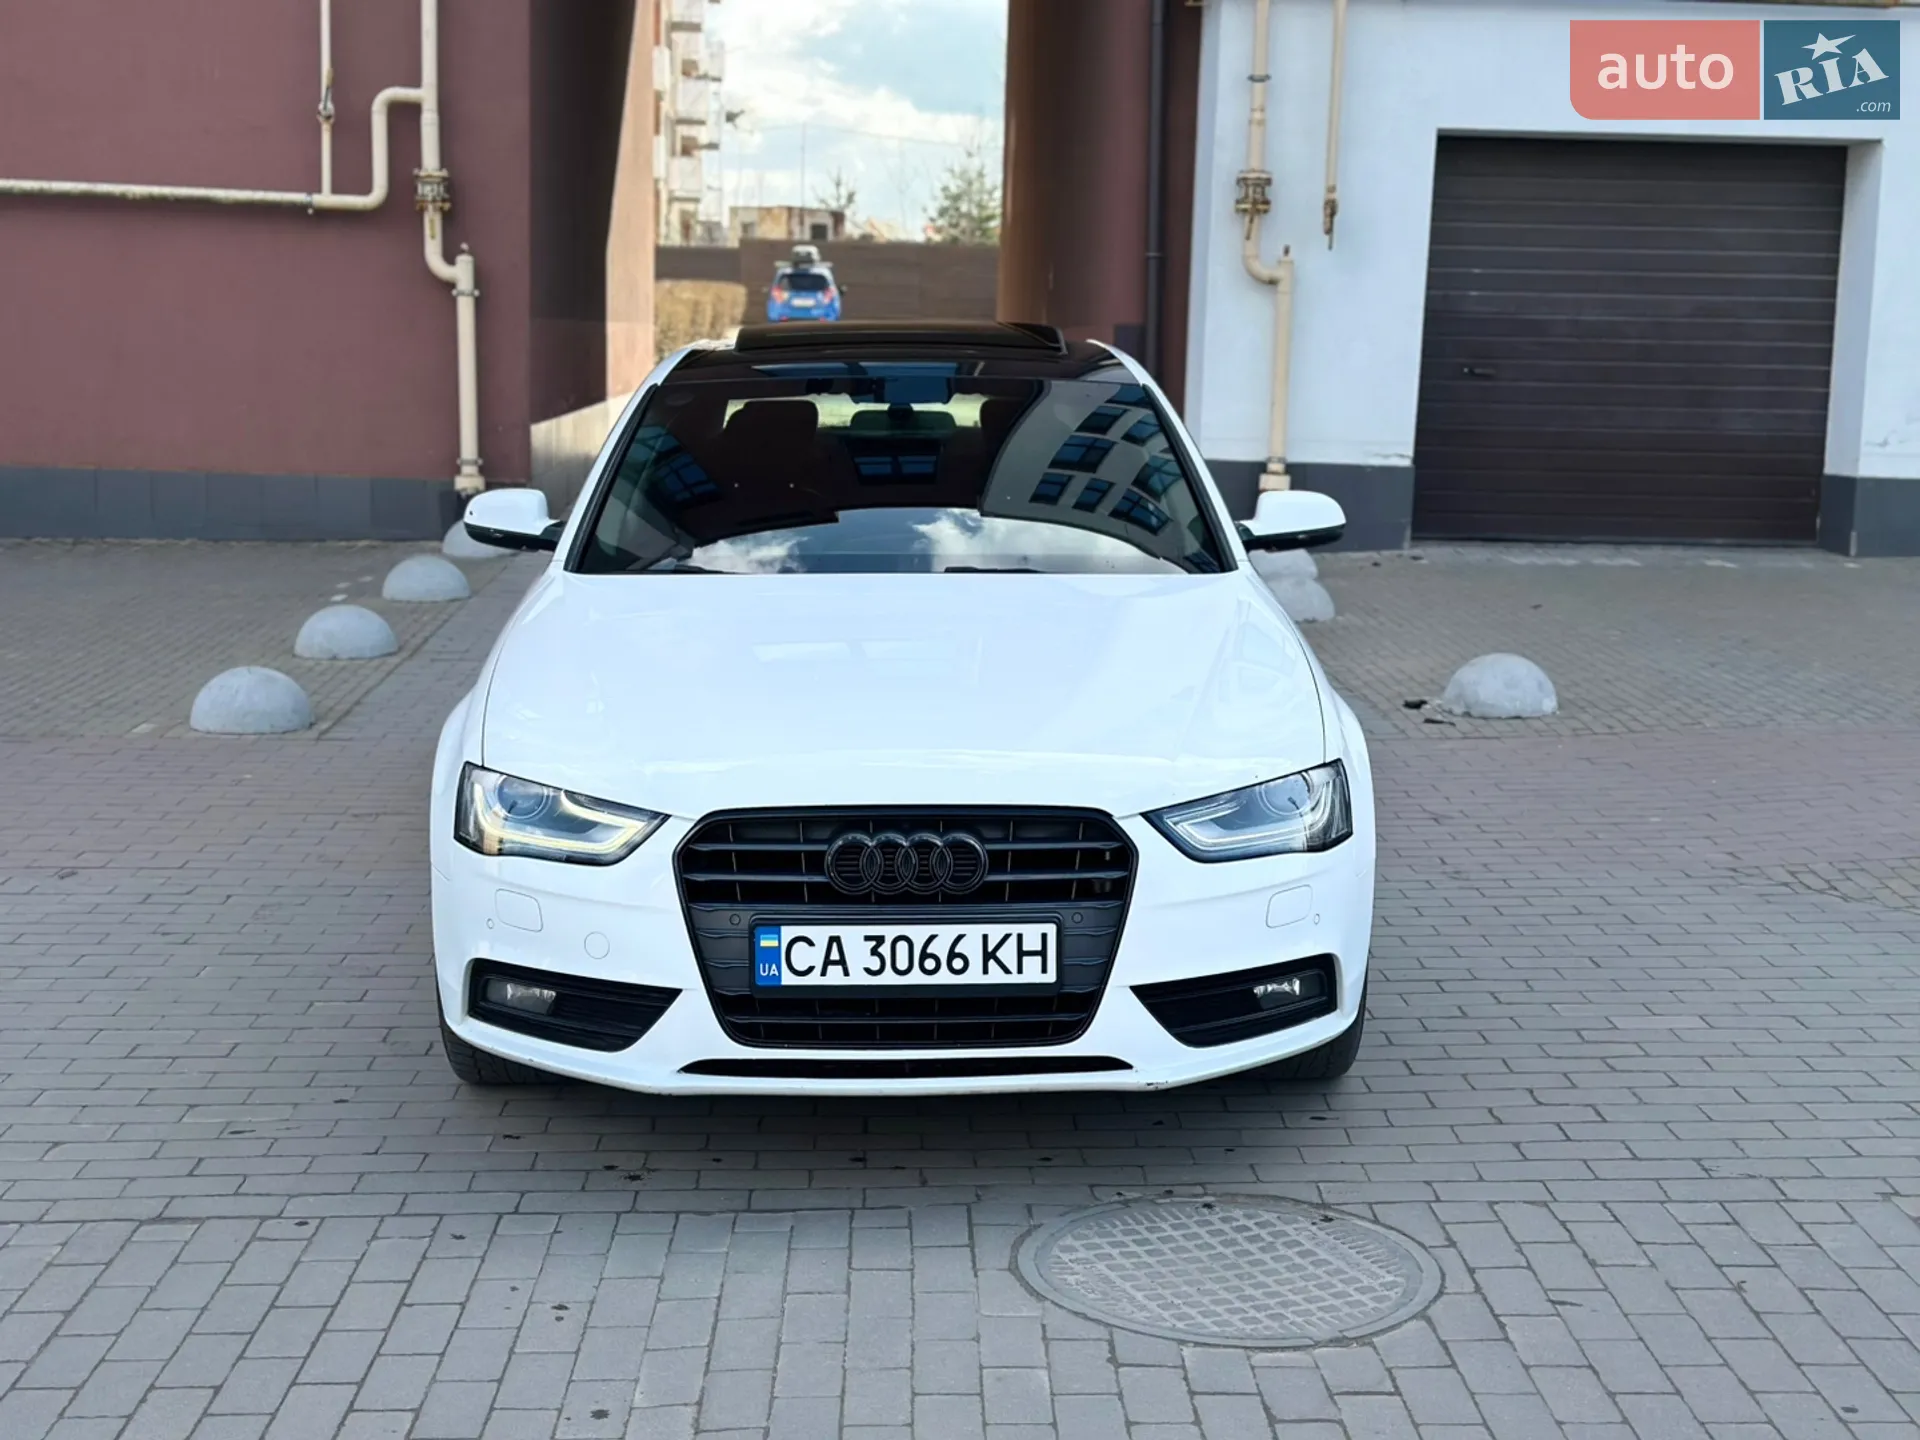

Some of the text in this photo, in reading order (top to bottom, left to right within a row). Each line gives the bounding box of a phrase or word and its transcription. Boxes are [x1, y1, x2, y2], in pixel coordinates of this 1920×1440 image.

[784, 932, 1048, 977] CA 3066 KH
[759, 963, 779, 977] UA
